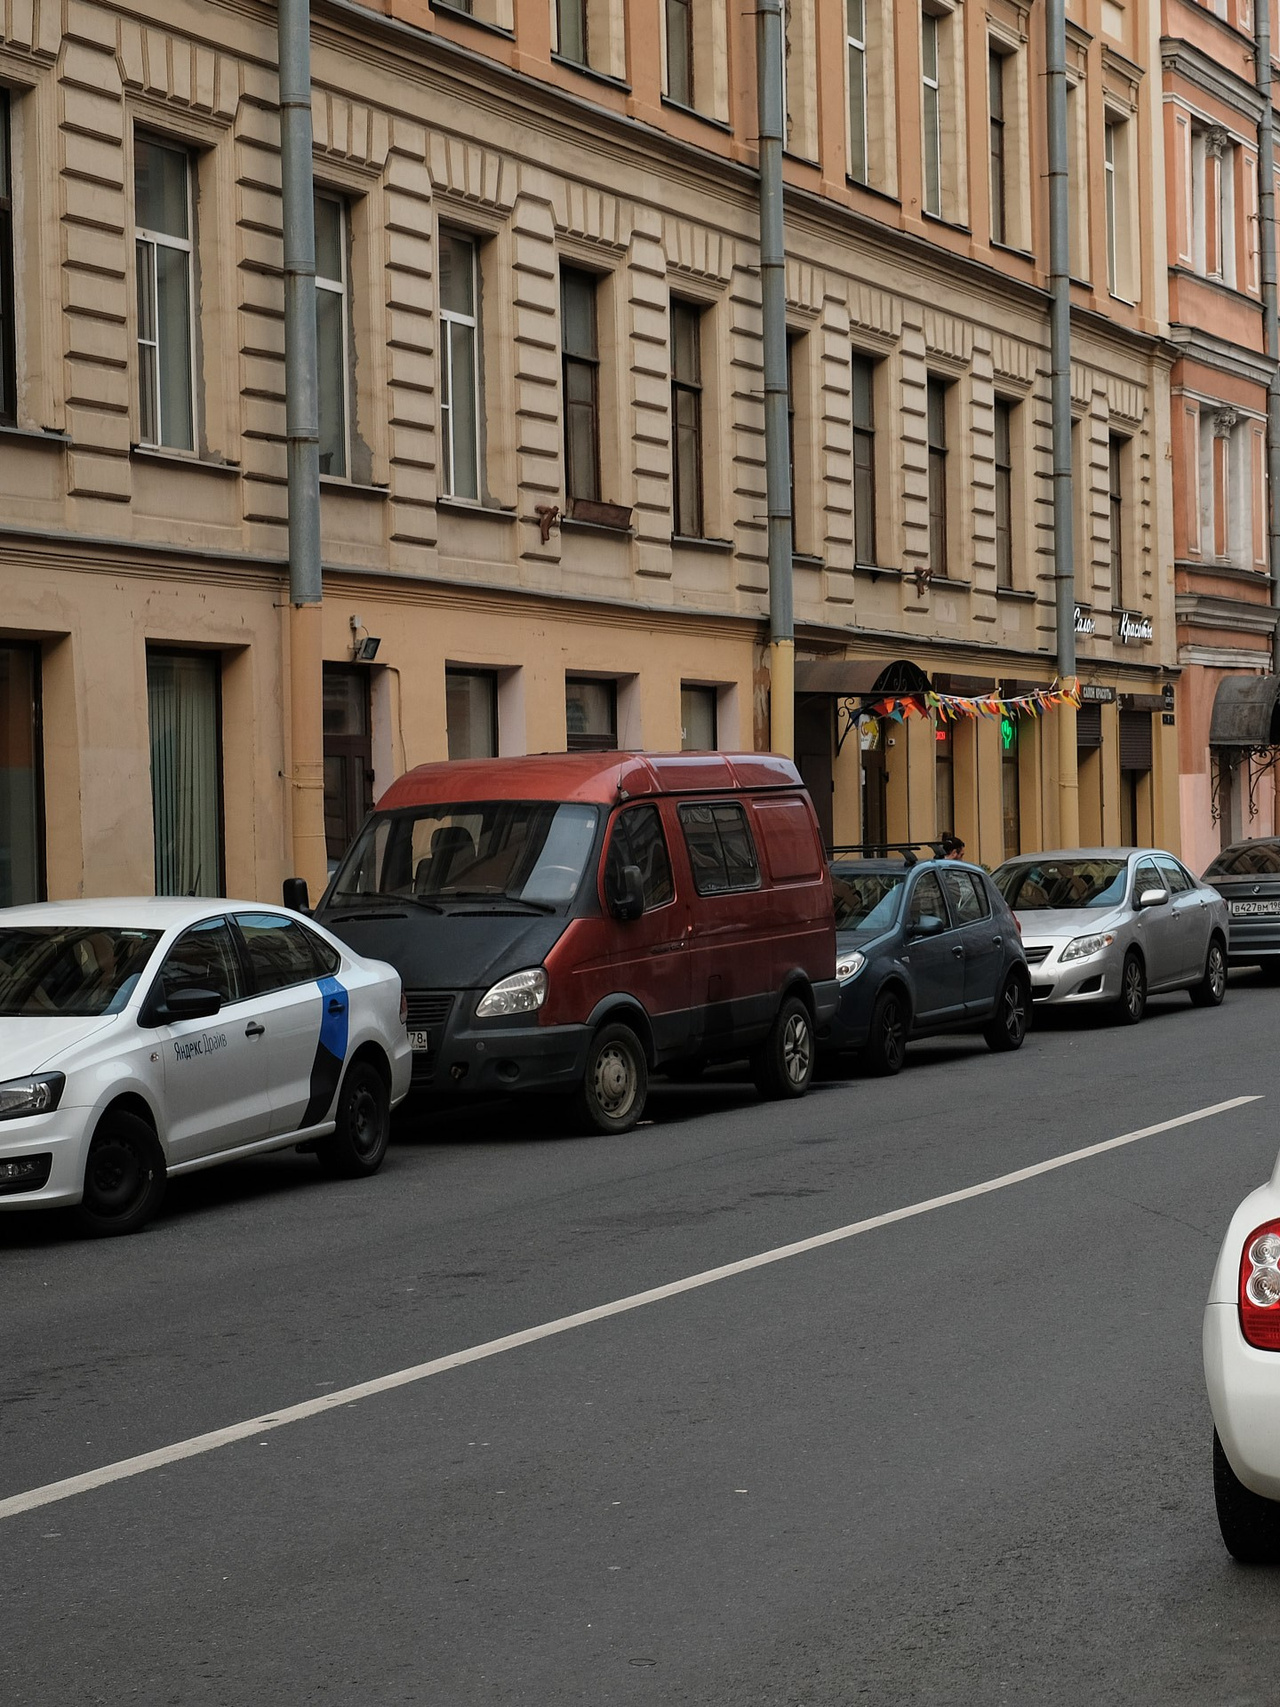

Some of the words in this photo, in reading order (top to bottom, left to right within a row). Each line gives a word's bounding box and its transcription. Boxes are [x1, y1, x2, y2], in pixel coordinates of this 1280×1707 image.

[1235, 903, 1268, 913] В427ВМ
[174, 1040, 203, 1061] Яндекс
[202, 1032, 228, 1055] Драйв
